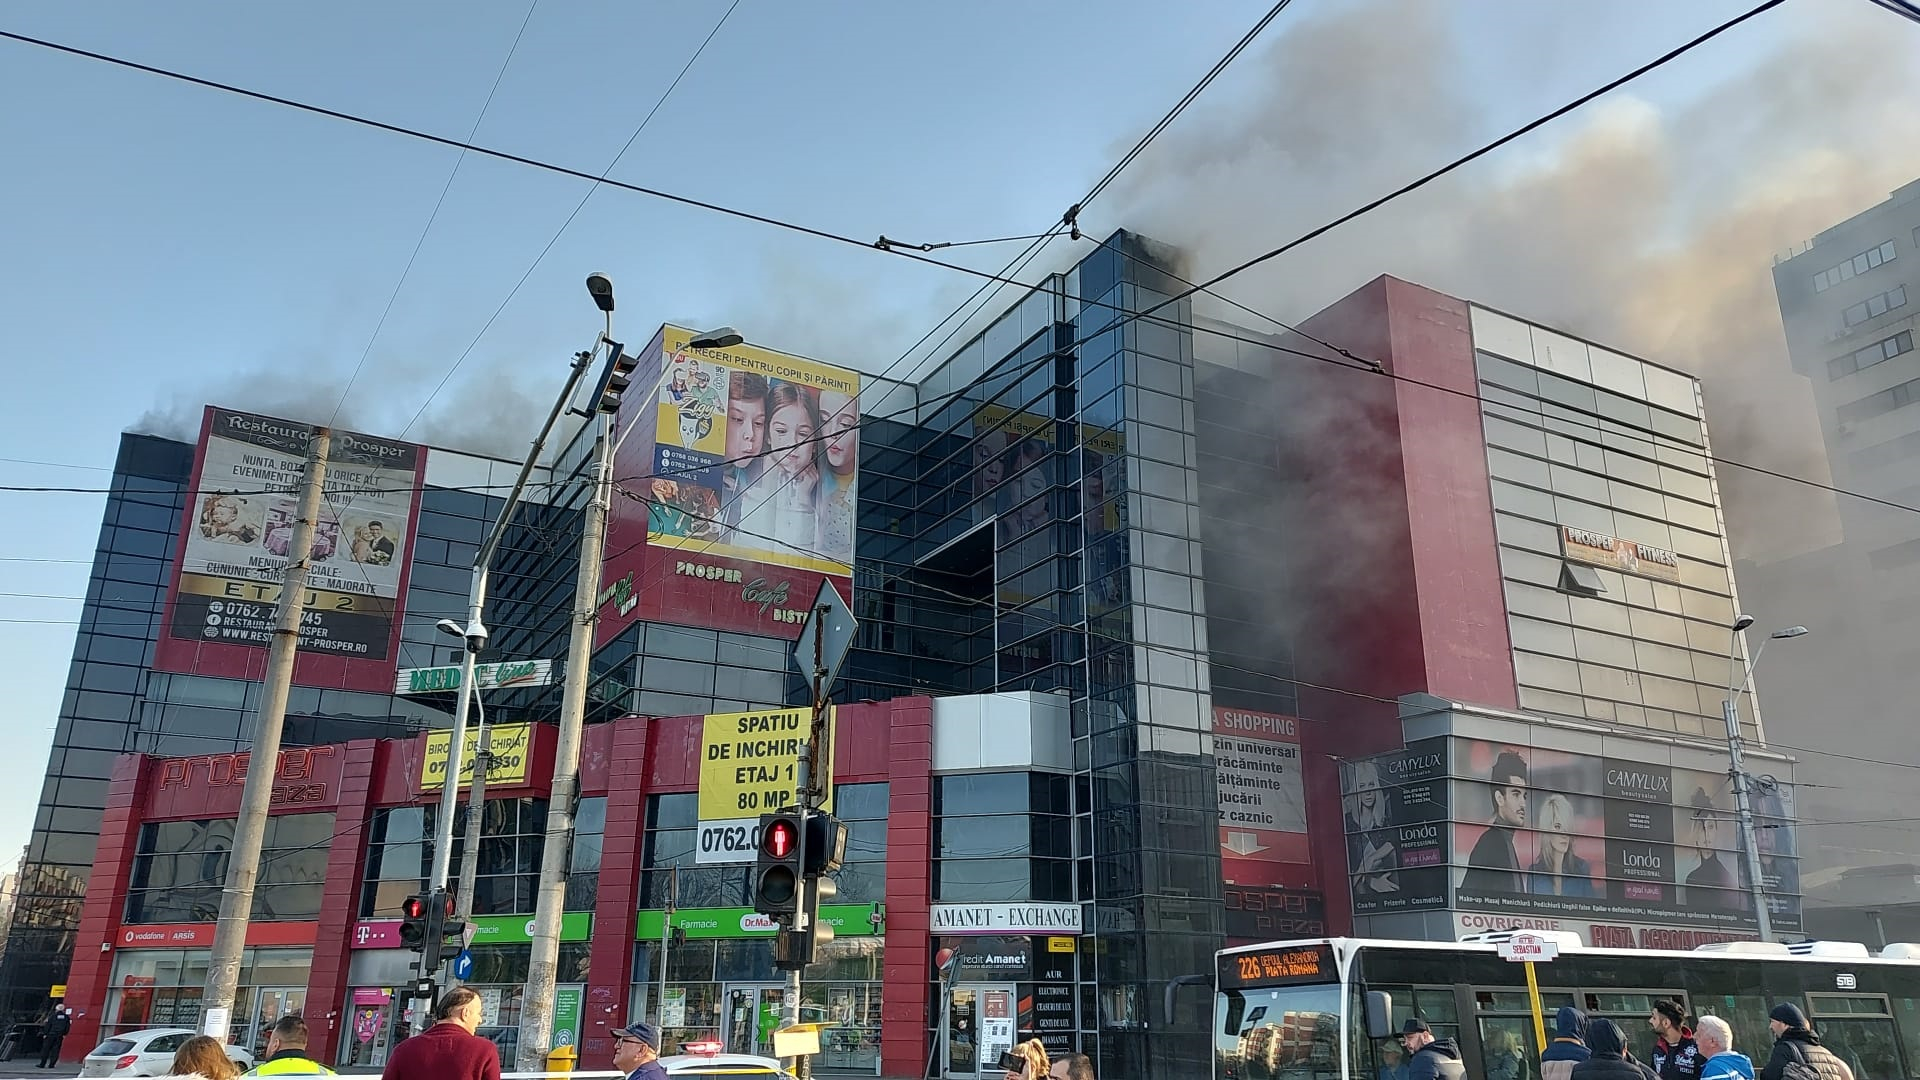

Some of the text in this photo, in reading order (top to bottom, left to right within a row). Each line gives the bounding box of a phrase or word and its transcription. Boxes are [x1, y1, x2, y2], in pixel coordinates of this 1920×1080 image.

[734, 356, 774, 372] PENTRU
[776, 366, 801, 379] COPII
[227, 415, 309, 441] Restaura
[232, 465, 289, 484] EVENIMENT
[334, 470, 361, 483] ORICE
[364, 475, 380, 486] ALT
[1567, 527, 1678, 567] PROSPER FITNESS
[206, 562, 250, 577] CUNUNIE
[326, 578, 377, 594] MAJORATE
[307, 564, 342, 578] CIALE:
[675, 561, 743, 584] PROSPER
[224, 581, 354, 611] ETJ 2
[773, 608, 809, 625] BIST
[299, 626, 329, 637] OSPER
[409, 665, 490, 692] MEDC
[737, 713, 799, 733] SPATIU
[1223, 711, 1295, 736] SHOPPING
[491, 737, 527, 750] CHIRIAT
[708, 738, 804, 760] DE INCHIR
[1237, 740, 1296, 758] universal
[1217, 755, 1283, 774] răcăminte
[1388, 753, 1441, 774] CAMYLUX
[735, 764, 794, 784] ETAJ 1
[1218, 772, 1281, 790] ălțăminte
[1607, 769, 1670, 793] CAMYLUX
[270, 783, 327, 804] aza
[737, 790, 790, 810] 80 MP
[1230, 811, 1273, 824] caznic
[1400, 823, 1437, 841] Londa
[1401, 839, 1438, 849] PROFESSIONAL
[1623, 847, 1661, 869] Londa
[1623, 868, 1662, 877] PROFESSIONAL
[680, 918, 718, 929] Farmacie
[744, 917, 774, 928] Dr.Max
[934, 908, 993, 927] AMANET
[1009, 908, 1079, 927] EXCHANGE
[1461, 915, 1559, 931] COVRIGARIE
[135, 931, 165, 941] vodafone
[476, 925, 499, 935] macie
[1512, 944, 1542, 954] SEBASTIAN
[985, 953, 1026, 964] Amanet
[1238, 950, 1320, 979] 226 DEPOUL ALEXANDRIA
[1045, 971, 1063, 979] AUR
[1265, 963, 1319, 977] PIATA ROMANA
[1041, 1035, 1069, 1044] DIAMANTE
